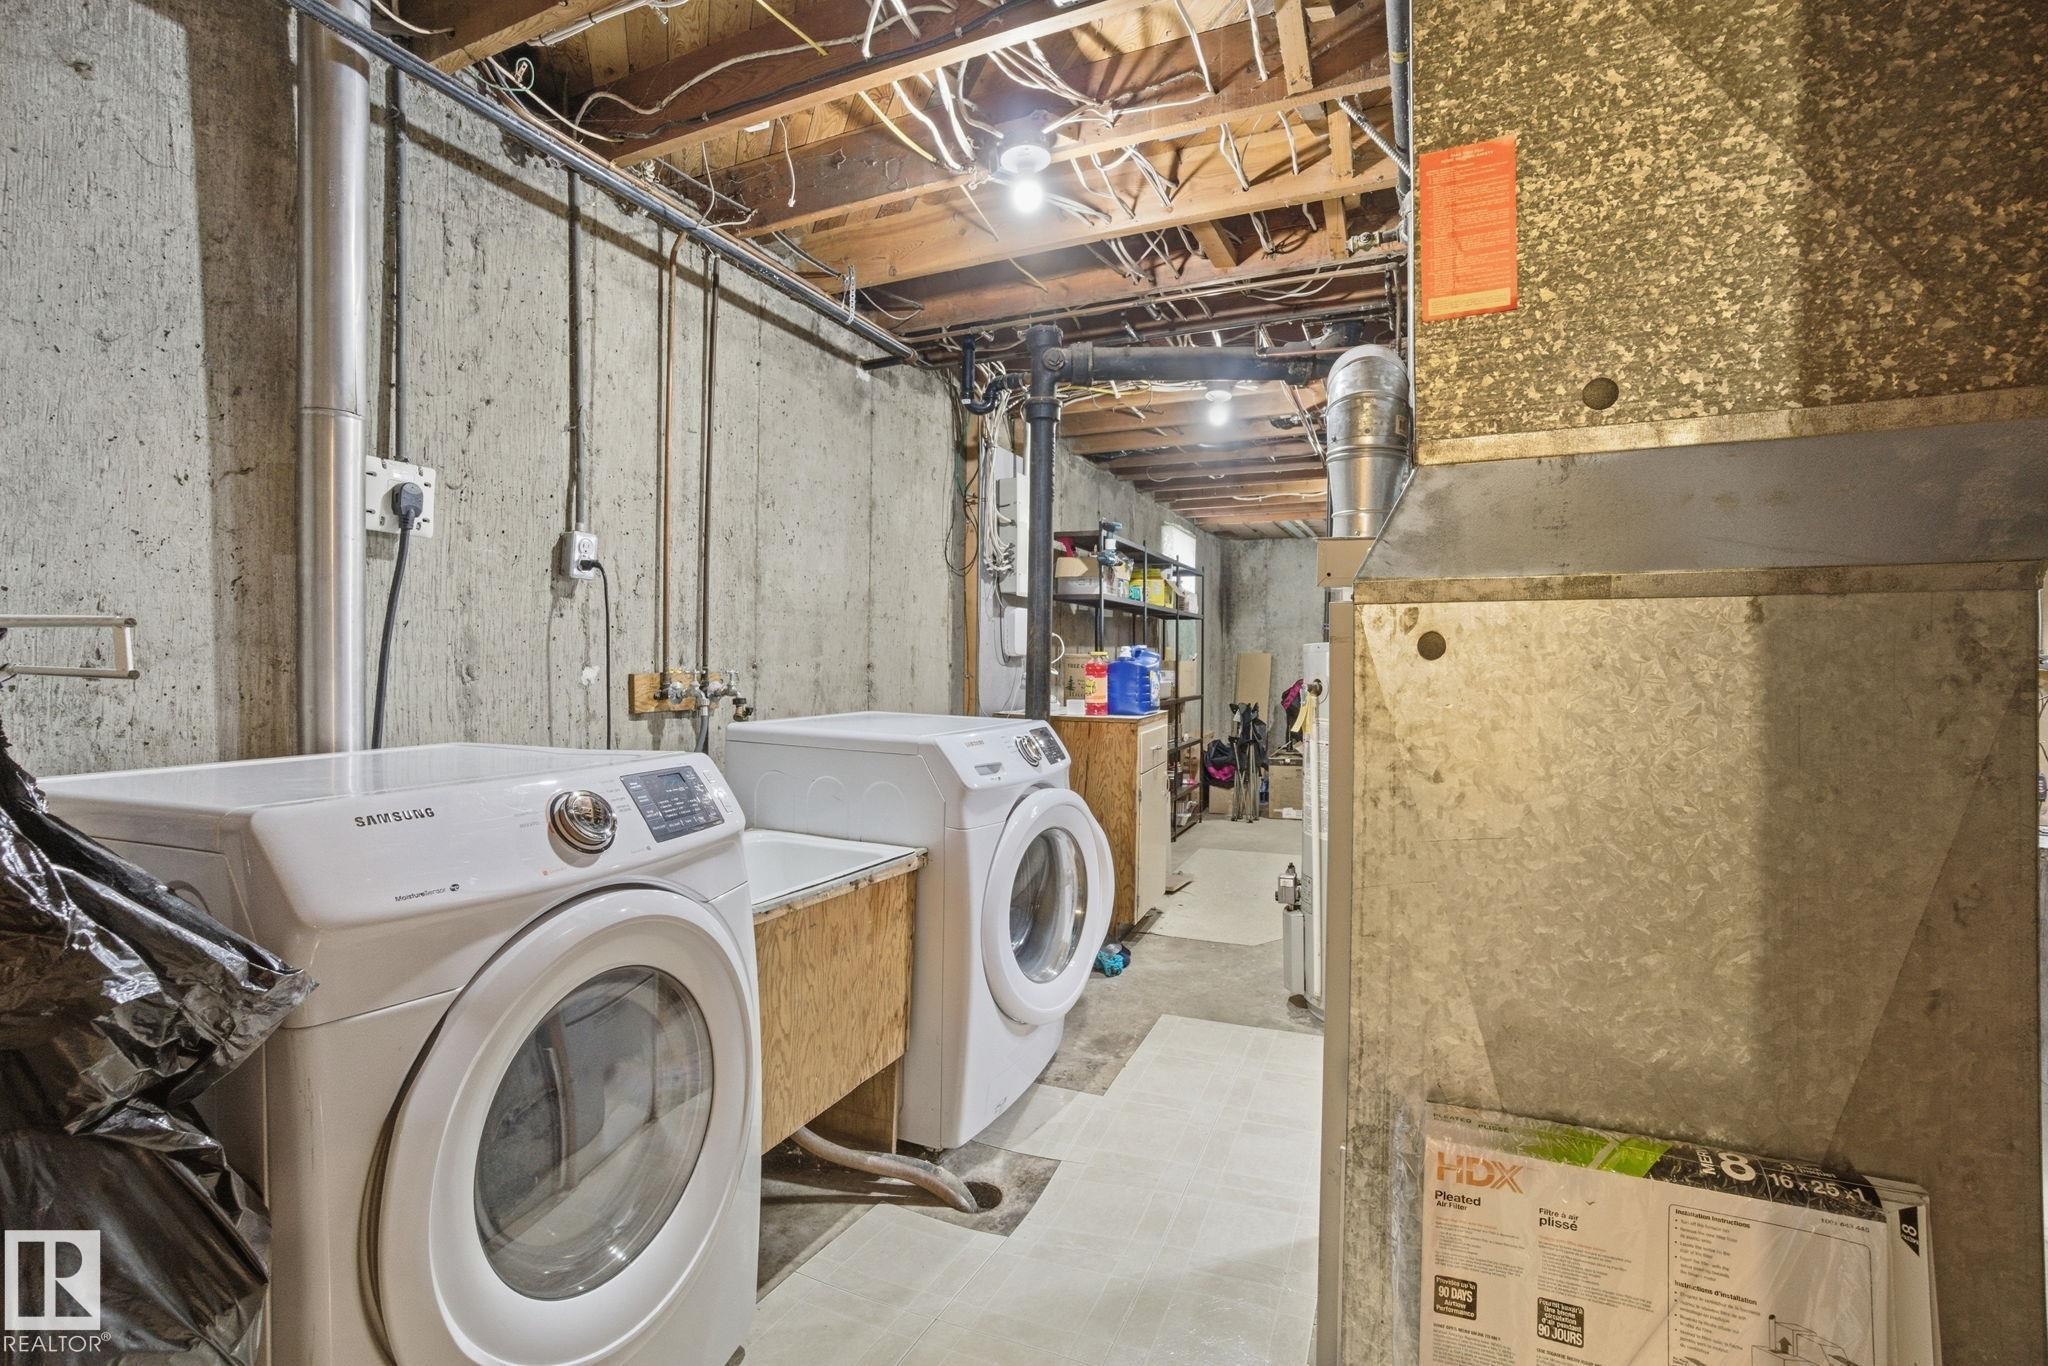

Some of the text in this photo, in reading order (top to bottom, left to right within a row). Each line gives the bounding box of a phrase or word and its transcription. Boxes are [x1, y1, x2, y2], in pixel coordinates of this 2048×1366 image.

[354, 807, 435, 827] SAMSUNG
[1436, 1151, 1524, 1194] HDX
[1717, 1151, 1756, 1181] 8
[1768, 1173, 1794, 1189] 16
[1798, 1182, 1809, 1192] x
[1810, 1180, 1840, 1197] 25
[1434, 1190, 1481, 1206] Pleated
[1436, 1200, 1467, 1211] Air Filter
[1539, 1207, 1560, 1217] Filtre
[1568, 1214, 1579, 1222] air
[1675, 1208, 1751, 1229] Installation Instructions
[1539, 1217, 1578, 1232] plissé
[1901, 1223, 1917, 1237] 8
[1438, 1285, 1473, 1303] 90 DAYS
[1674, 1279, 1758, 1306] Instructions d'installation
[1444, 1299, 1467, 1309] Airflow
[1538, 1323, 1583, 1346] 90 JOURS
